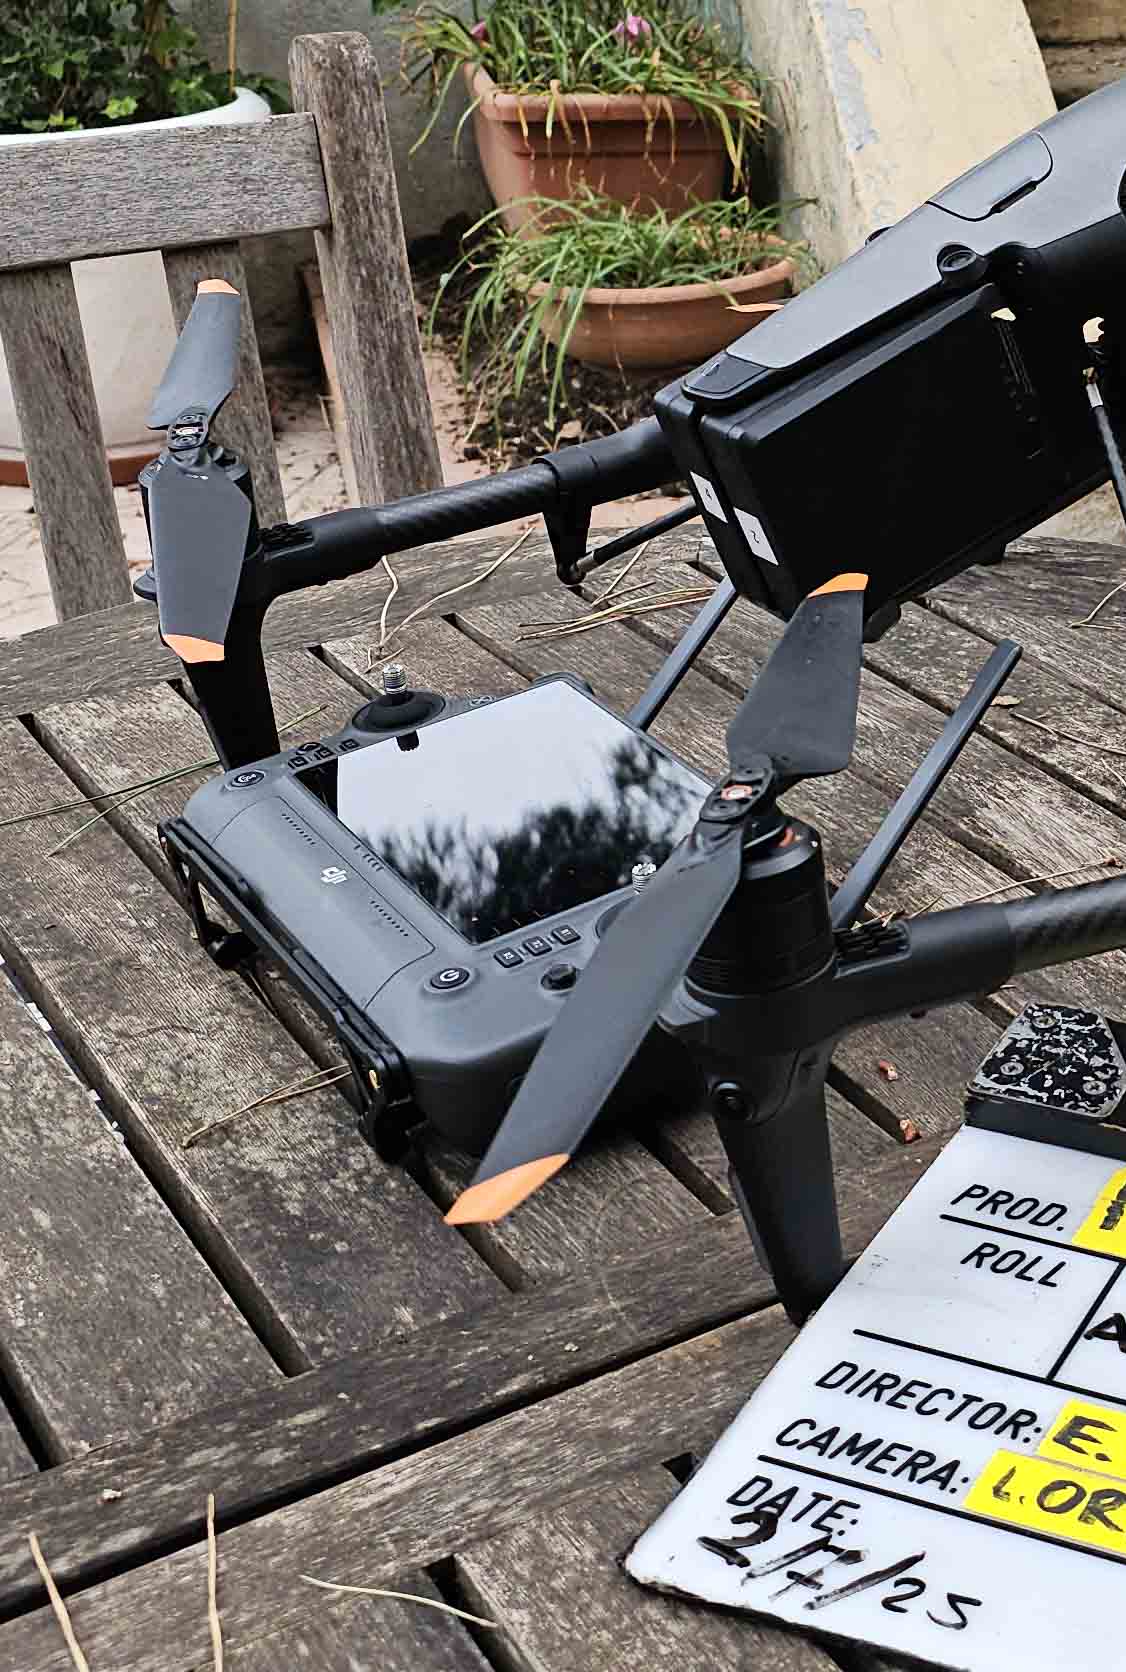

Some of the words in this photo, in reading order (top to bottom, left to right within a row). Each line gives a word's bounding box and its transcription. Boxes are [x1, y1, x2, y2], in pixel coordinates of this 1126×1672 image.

[950, 1183, 1068, 1232] PROD.
[959, 1241, 1067, 1288] ROLL
[815, 1360, 1043, 1444] DIRECTOR:
[774, 1418, 970, 1494] CAMERA:
[726, 1474, 861, 1537] DATE:
